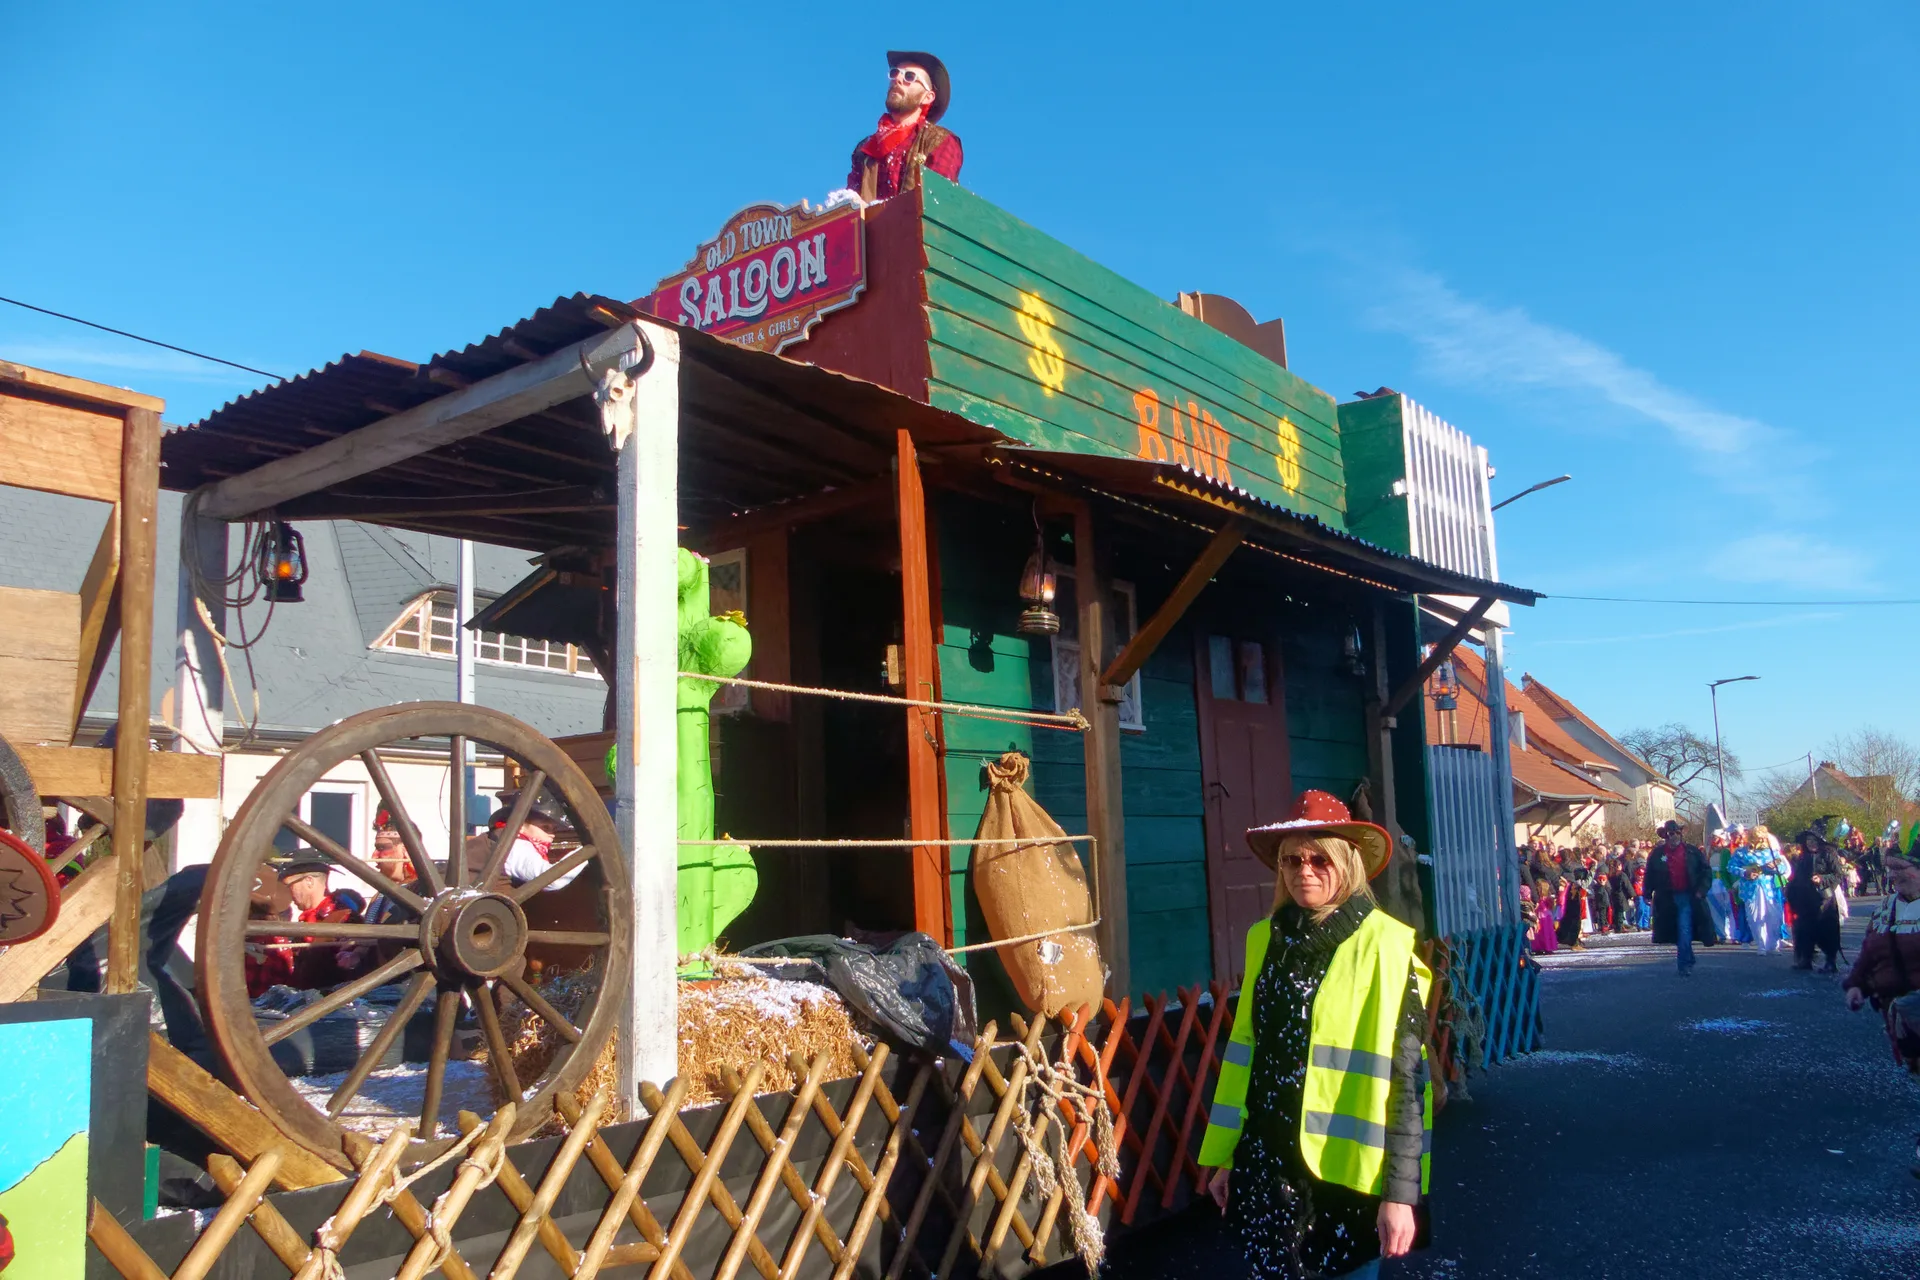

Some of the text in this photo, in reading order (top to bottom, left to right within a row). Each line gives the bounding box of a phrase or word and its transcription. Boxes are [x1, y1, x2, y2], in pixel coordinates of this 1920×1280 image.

[707, 215, 793, 271] OLD TOWN
[678, 232, 828, 330] SALOON
[769, 315, 800, 336] GIRLS
